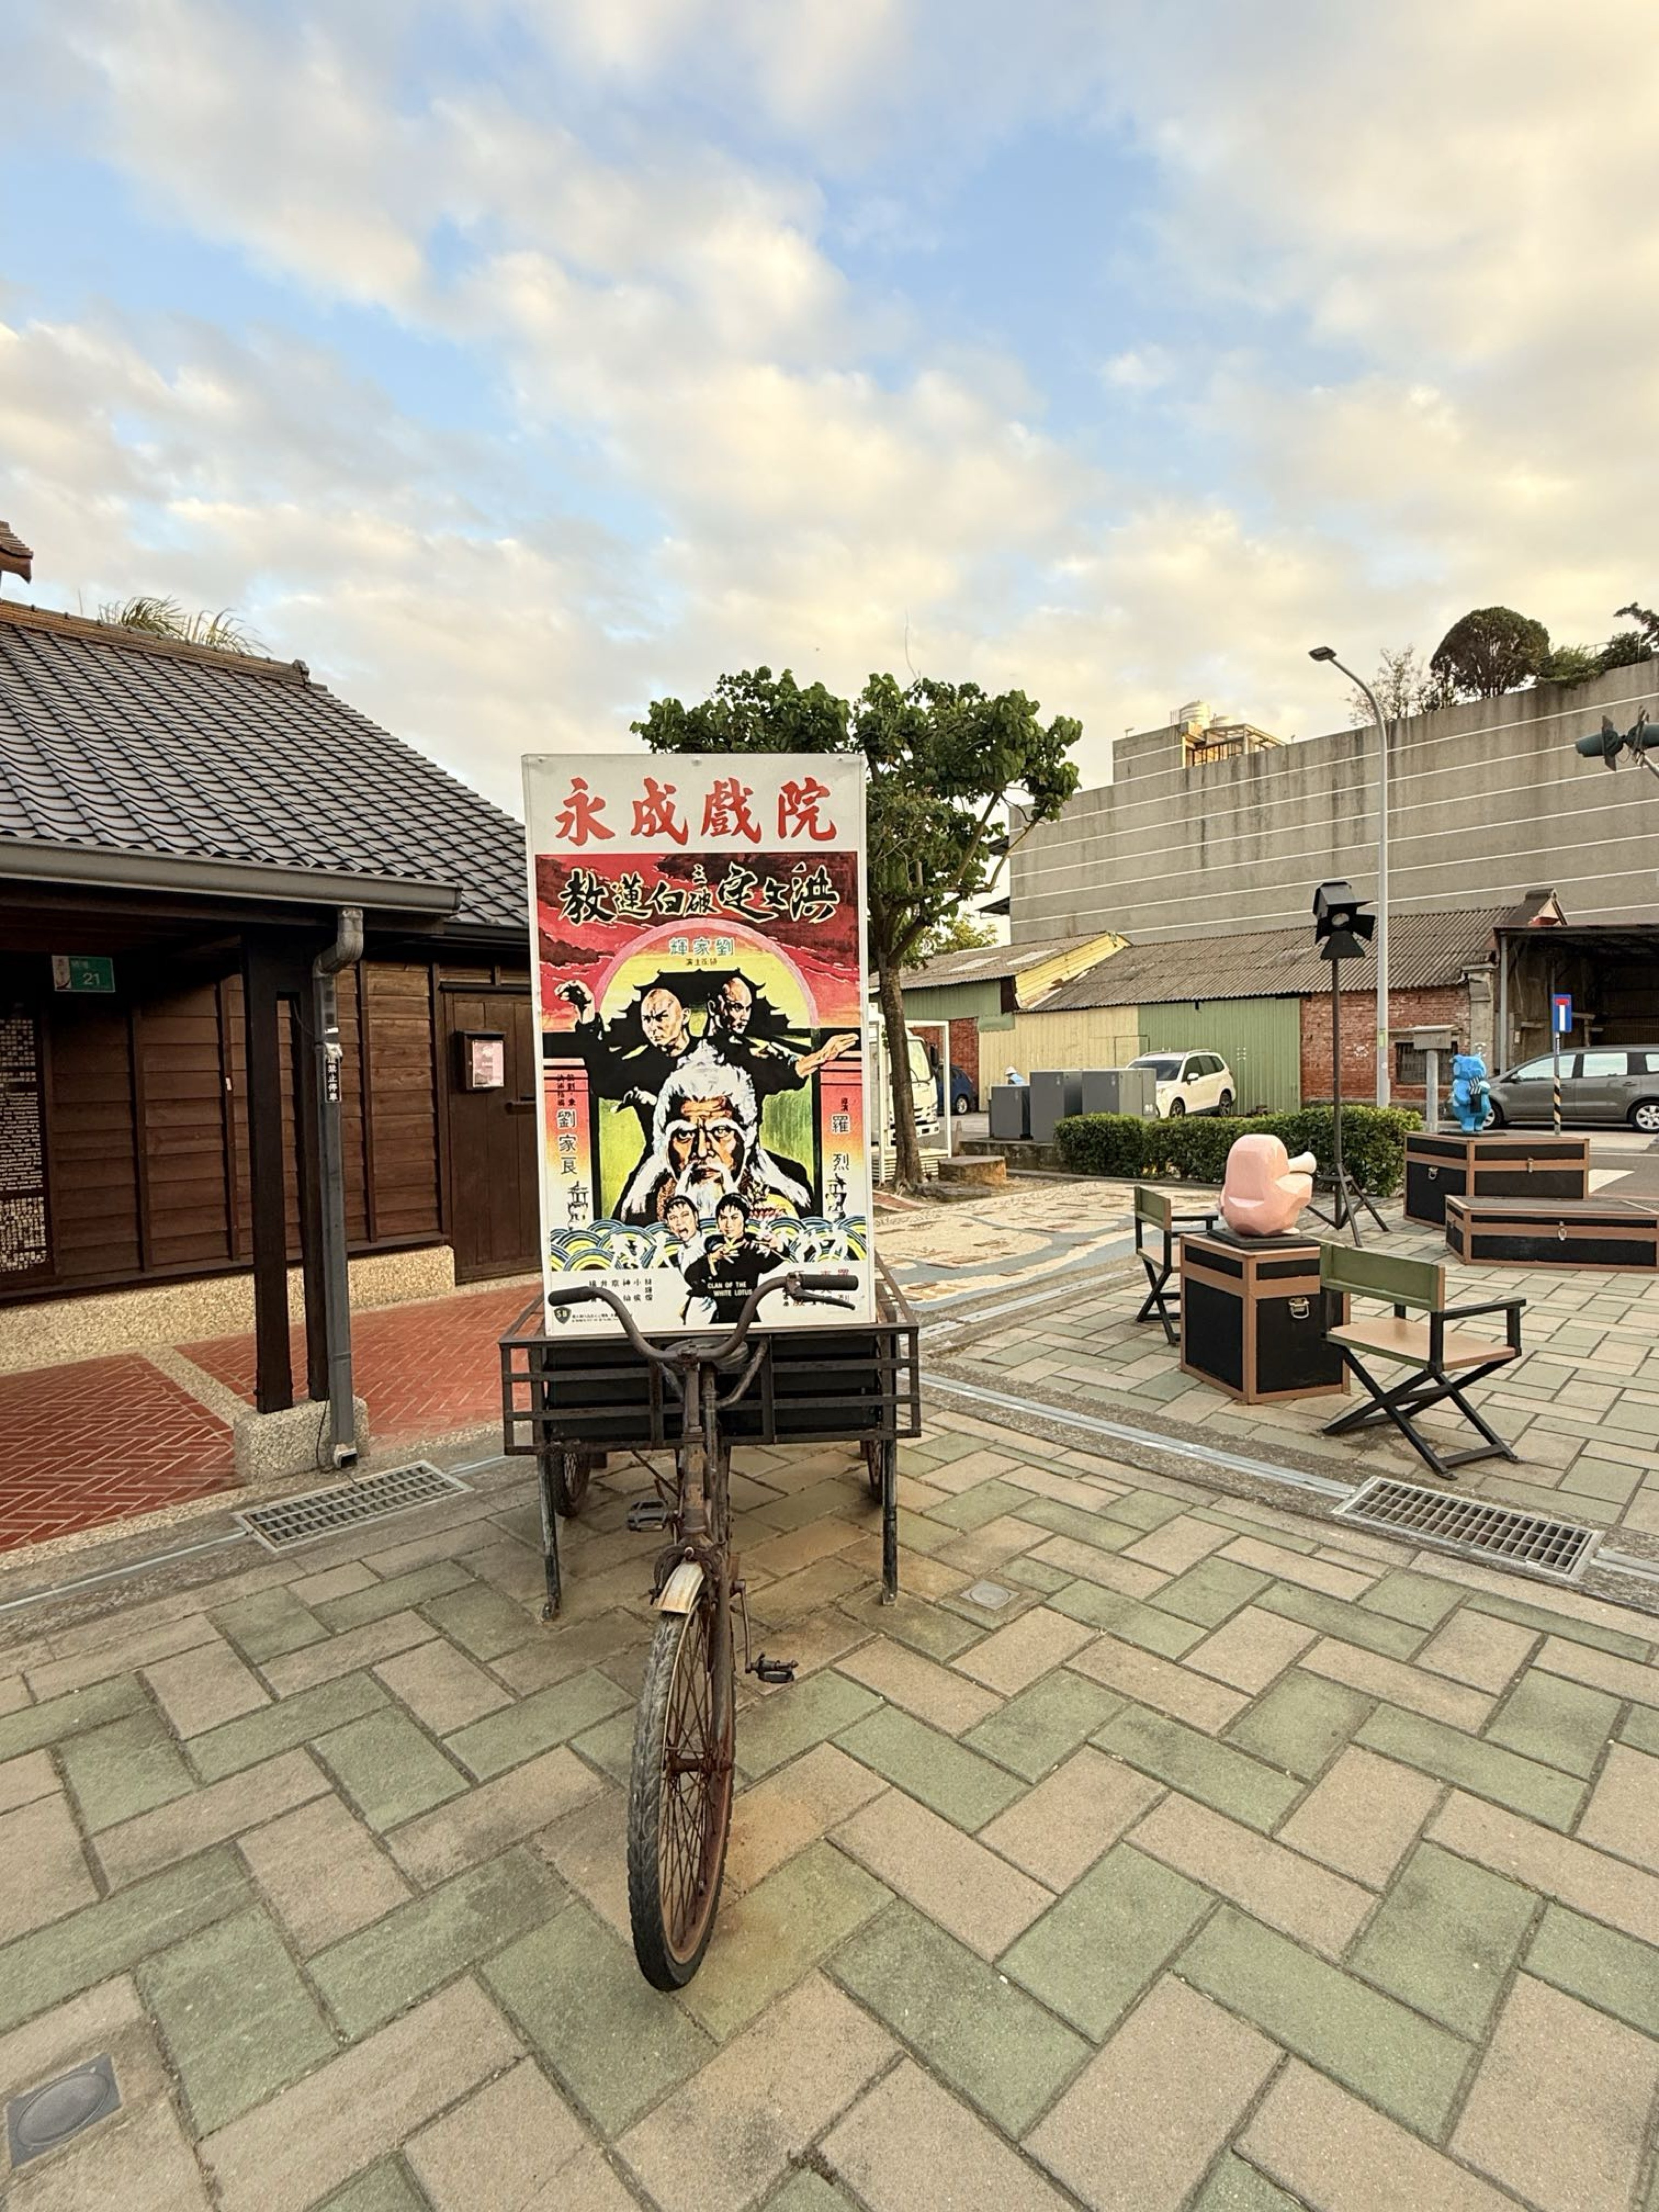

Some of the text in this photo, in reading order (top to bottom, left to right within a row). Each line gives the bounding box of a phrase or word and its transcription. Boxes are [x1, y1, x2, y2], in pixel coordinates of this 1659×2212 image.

[555, 777, 837, 847] 永成戲院
[83, 973, 99, 986] 21
[558, 1111, 577, 1175] 劉家良
[832, 1115, 849, 1171] 羅烈
